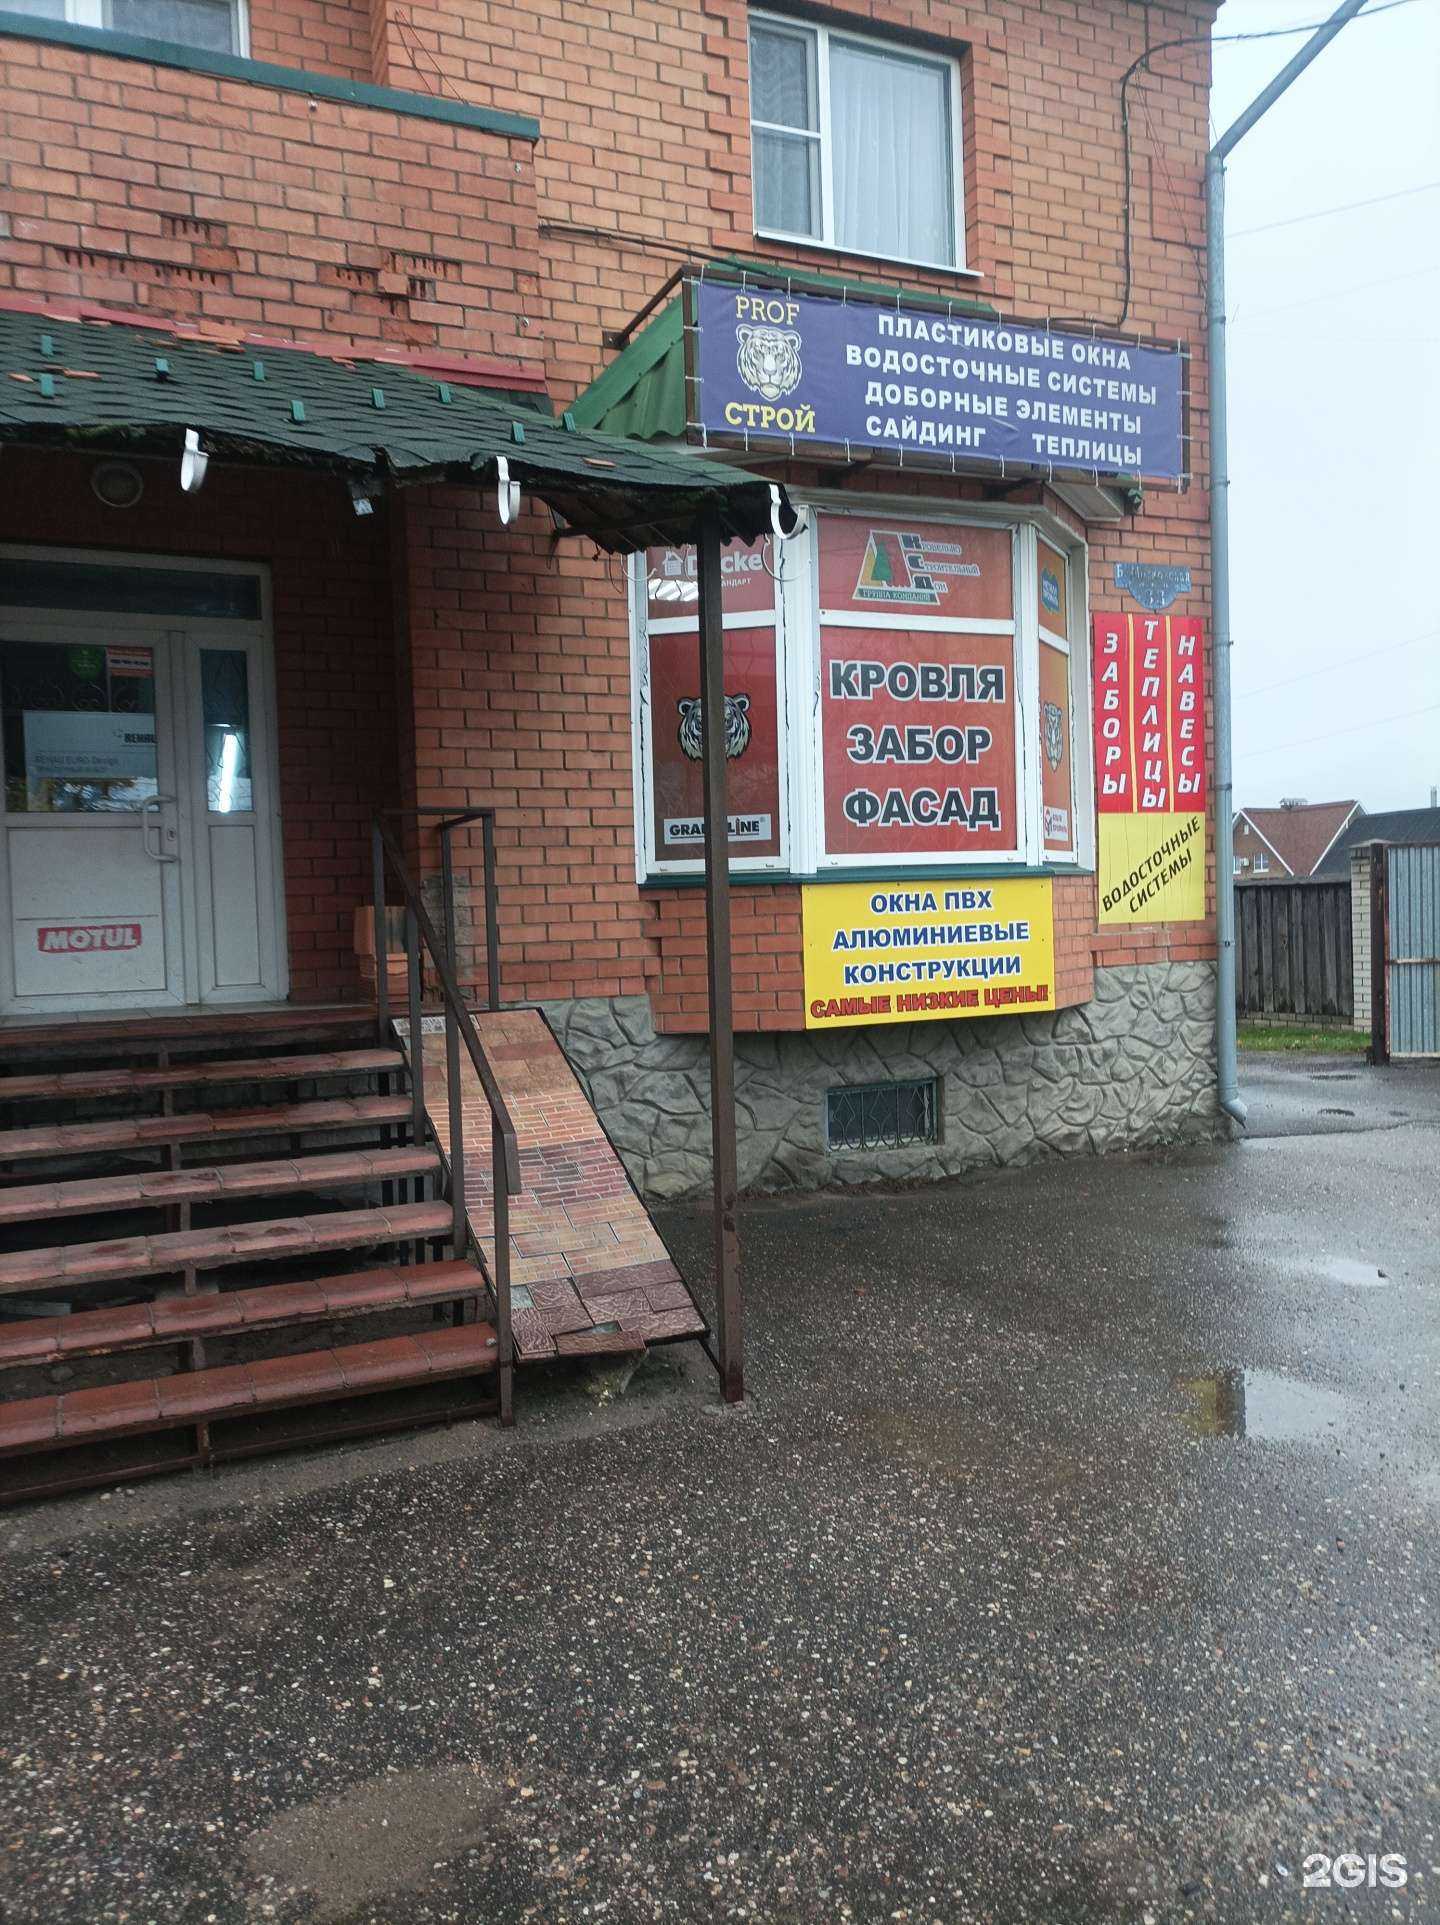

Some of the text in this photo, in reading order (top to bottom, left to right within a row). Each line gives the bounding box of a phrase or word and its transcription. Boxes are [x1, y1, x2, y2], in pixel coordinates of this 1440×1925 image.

[736, 295, 800, 325] PROF
[878, 314, 1131, 371] ПЛАСТИКОВЫЕ ОКНА
[846, 344, 1157, 405] ВОДОСТОЧНЫЕ СИСТЕМЫ
[725, 402, 817, 433] СТРОЙ
[865, 381, 1141, 434] ДОБОРНЫЕ ЭЛЕМЕНТЫ
[866, 415, 1142, 466] САЙДИНГ ТЕПЛИЦЫ
[829, 661, 1005, 703] КРОВЛЯ
[1102, 632, 1126, 794] ЗАБОРЫ
[1142, 620, 1166, 808] ТЕПЛИЦЫ
[1178, 635, 1200, 793] НАВЕСЫ
[846, 725, 992, 763] ЗАБОР
[843, 787, 1000, 831] ФАСАД
[1102, 816, 1200, 912] ВОДОСТОЧНЫЕ
[1129, 848, 1193, 913] СИСТЕМЫ
[871, 890, 992, 912] ОКНА ПВХ
[43, 927, 137, 950] MOTUL
[833, 922, 1029, 950] АЛЮМИНИЕВЫЕ
[844, 956, 1021, 984] КОНСТРУКЦИИ
[811, 995, 891, 1018] САМЫЕ
[897, 990, 979, 1011] НИЗКИЕ
